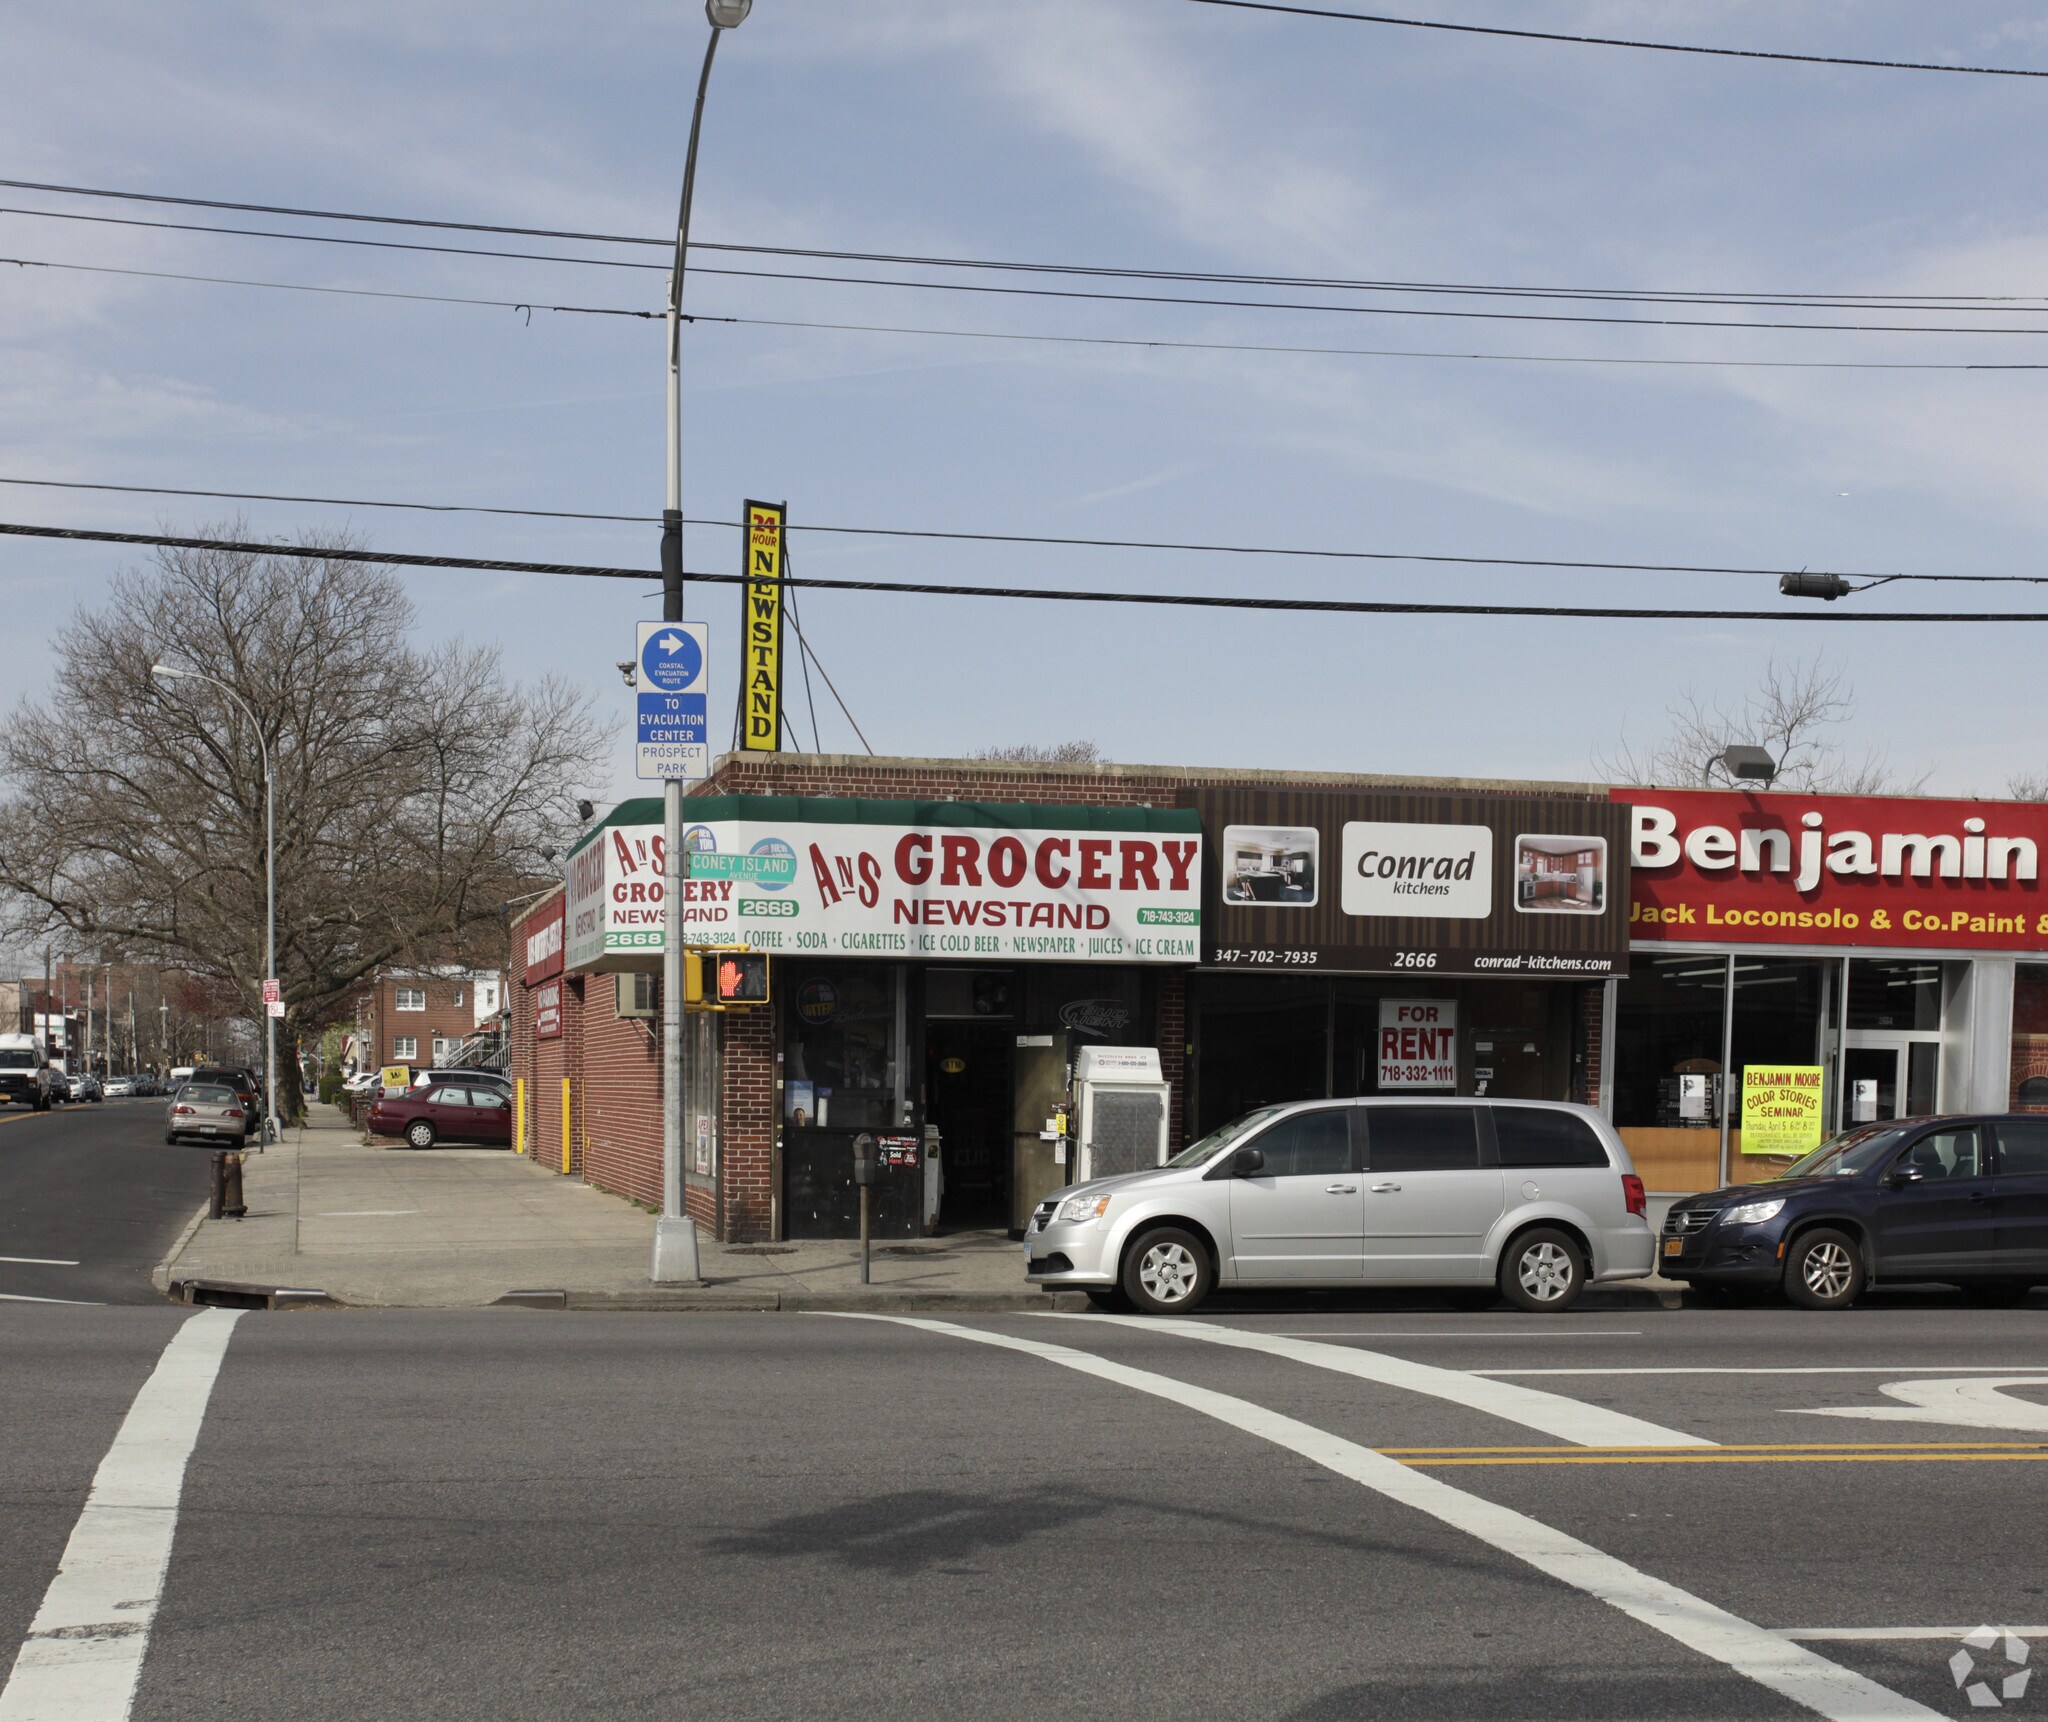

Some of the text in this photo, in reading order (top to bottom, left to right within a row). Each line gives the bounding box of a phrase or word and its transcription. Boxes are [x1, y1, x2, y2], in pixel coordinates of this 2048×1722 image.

[753, 513, 777, 534] 24
[751, 533, 777, 548] HOUR
[750, 549, 777, 739] NEWSTAND
[664, 698, 679, 710] TO
[640, 714, 704, 725] EVACUATION
[650, 730, 694, 741] CENTER
[642, 747, 701, 758] PROSPECT
[657, 763, 687, 774] PARK
[698, 828, 711, 838] NEW
[699, 838, 714, 851] YORK
[770, 843, 788, 853] NEW
[1630, 805, 2039, 893] Benjamin
[692, 855, 789, 873] CONEY ISLAND
[894, 833, 1198, 891] GROCERY
[1357, 850, 1476, 881] Conrad
[728, 871, 759, 881] AVENUE
[613, 881, 733, 903] GROERY
[1393, 881, 1450, 895] kitchens
[742, 901, 794, 915] 2668
[893, 898, 1111, 931] NEWSTAND
[613, 908, 729, 924] NEWSAND
[1141, 910, 1195, 924] 718-743-3124
[1629, 902, 1696, 925] Jack
[1706, 903, 1860, 929] Loconsolo
[1869, 908, 1892, 930] &
[606, 933, 662, 946] 2668
[744, 930, 1194, 957] COFFEE SODA CIGARETTES ICE COLD BEER NEWSPAPER JUICES ICE CREAM
[1214, 949, 1318, 964] 347-702-7935
[1393, 952, 1438, 968] 2666
[1474, 955, 1612, 971] conrad-kitchens.com
[1397, 1006, 1439, 1023] FOR
[1381, 1026, 1454, 1061] RENT
[1381, 1065, 1454, 1082] 718-332-1111
[1746, 1072, 1821, 1087] BENJAMIN MOORE
[1746, 1088, 1818, 1110] COLOR STORIES
[1760, 1106, 1804, 1118] SEMINAR
[1745, 1121, 1767, 1131] Thursday
[1768, 1121, 1781, 1132] April
[1782, 1121, 1787, 1131] 5
